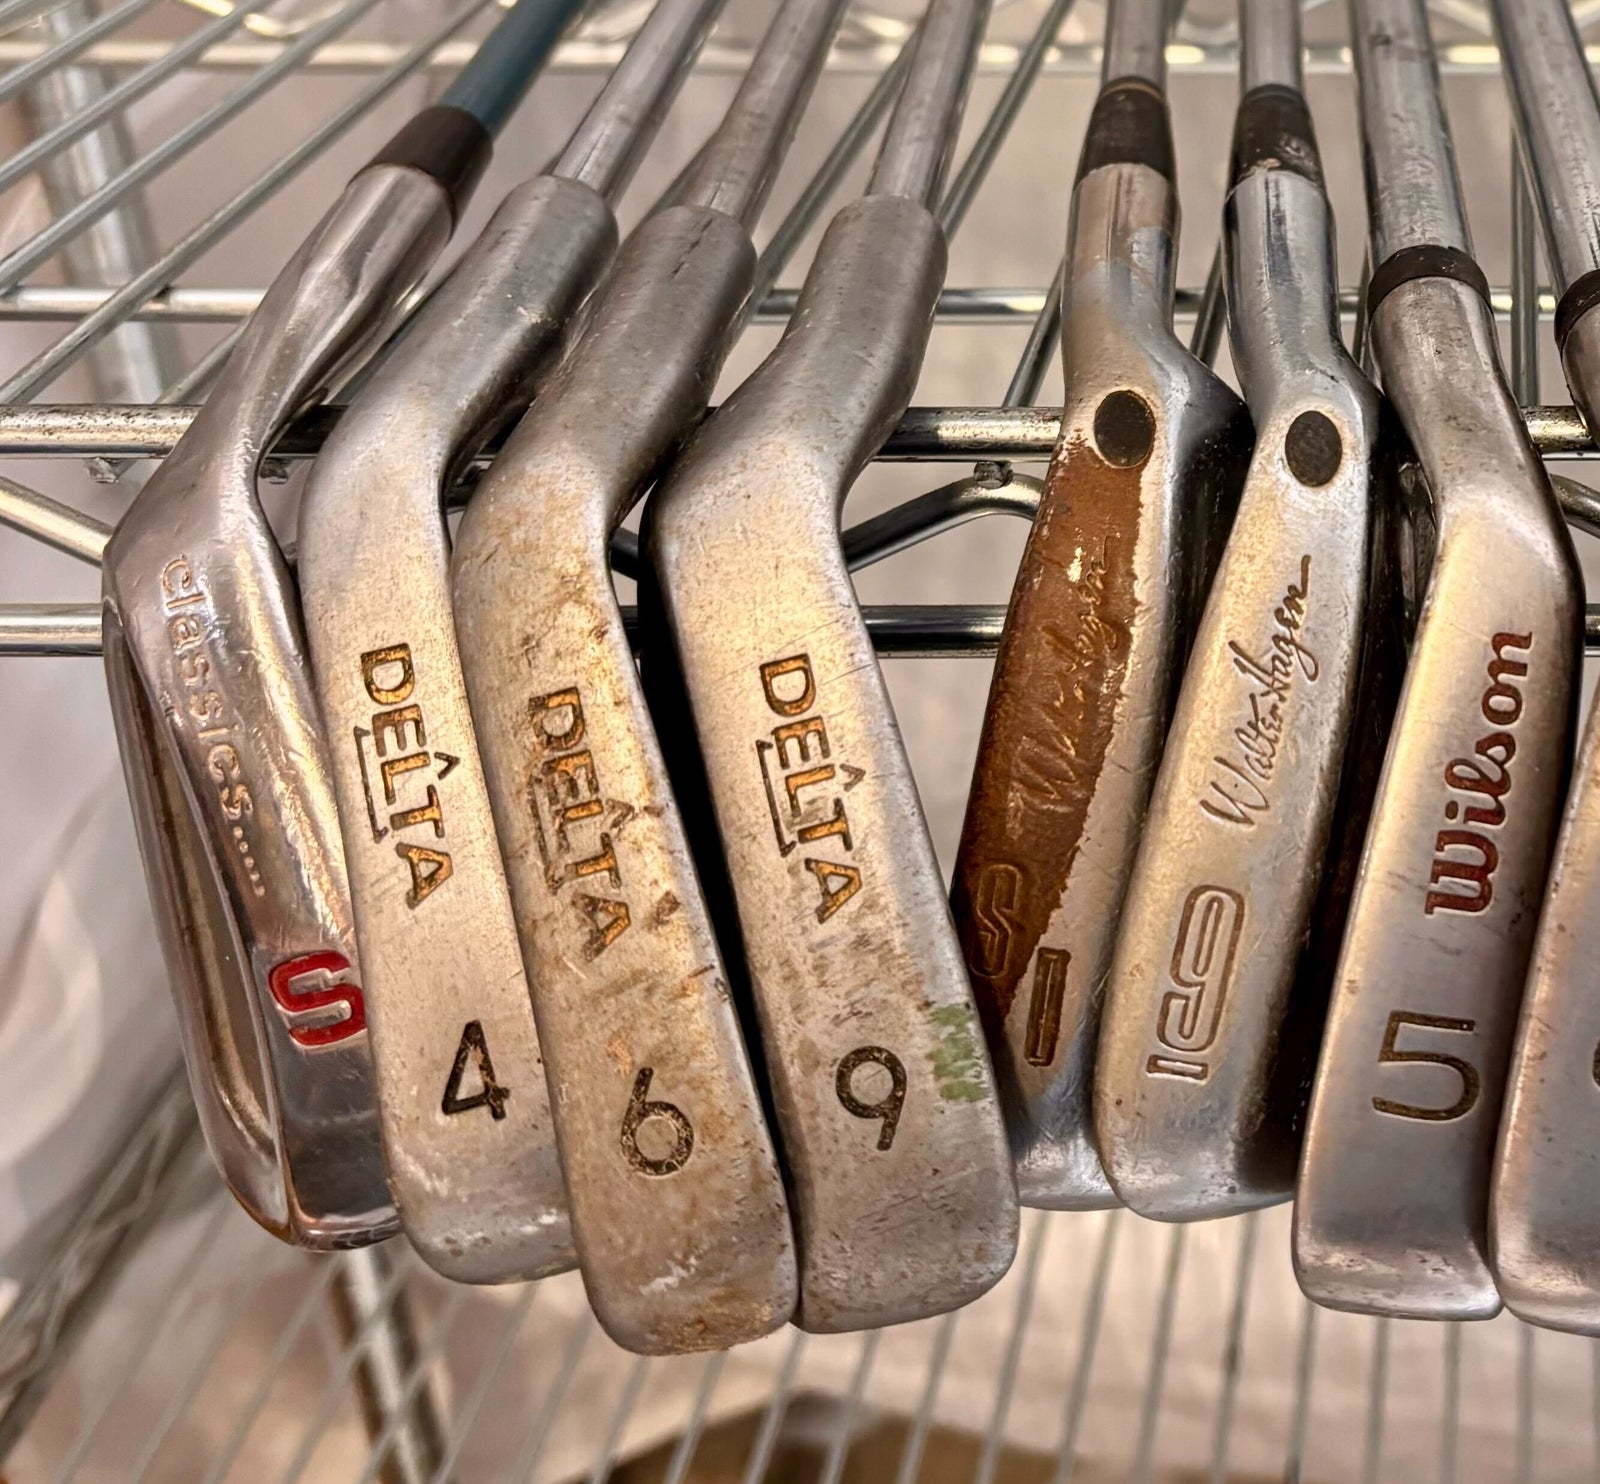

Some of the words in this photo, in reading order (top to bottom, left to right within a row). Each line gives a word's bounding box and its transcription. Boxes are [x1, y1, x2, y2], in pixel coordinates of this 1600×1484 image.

[1228, 554, 1318, 702] Hagen
[358, 642, 456, 909] DELTA
[529, 686, 634, 962] DELTA
[758, 654, 863, 923] DELTA
[1200, 693, 1285, 825] Walter
[1425, 631, 1533, 915] Wilson
[268, 949, 367, 1047] S
[1157, 884, 1246, 1053] 9
[442, 1020, 510, 1120] 4
[620, 1067, 694, 1177] 6
[836, 1046, 907, 1151] 9
[1372, 1010, 1480, 1121] 5
